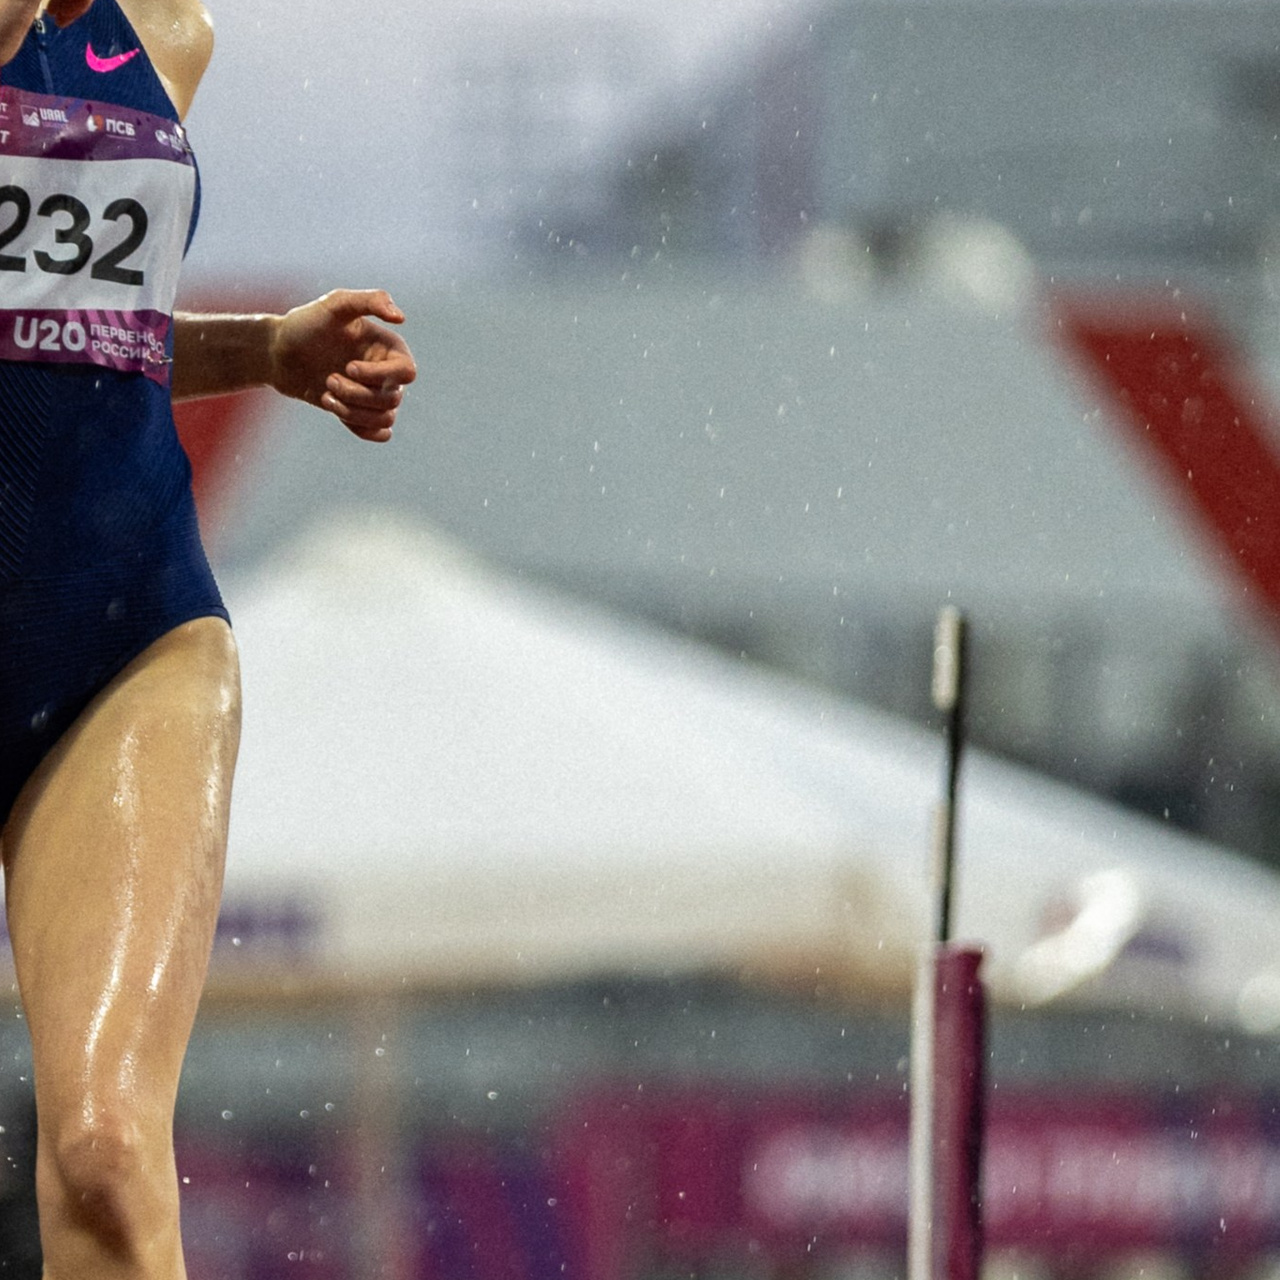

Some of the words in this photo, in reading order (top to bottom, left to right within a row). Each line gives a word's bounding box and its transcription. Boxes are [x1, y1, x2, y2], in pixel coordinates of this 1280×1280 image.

[39, 107, 69, 123] URAL
[106, 118, 136, 136] ПСБ
[13, 316, 86, 352] U20
[91, 340, 150, 359] РОССИИ
